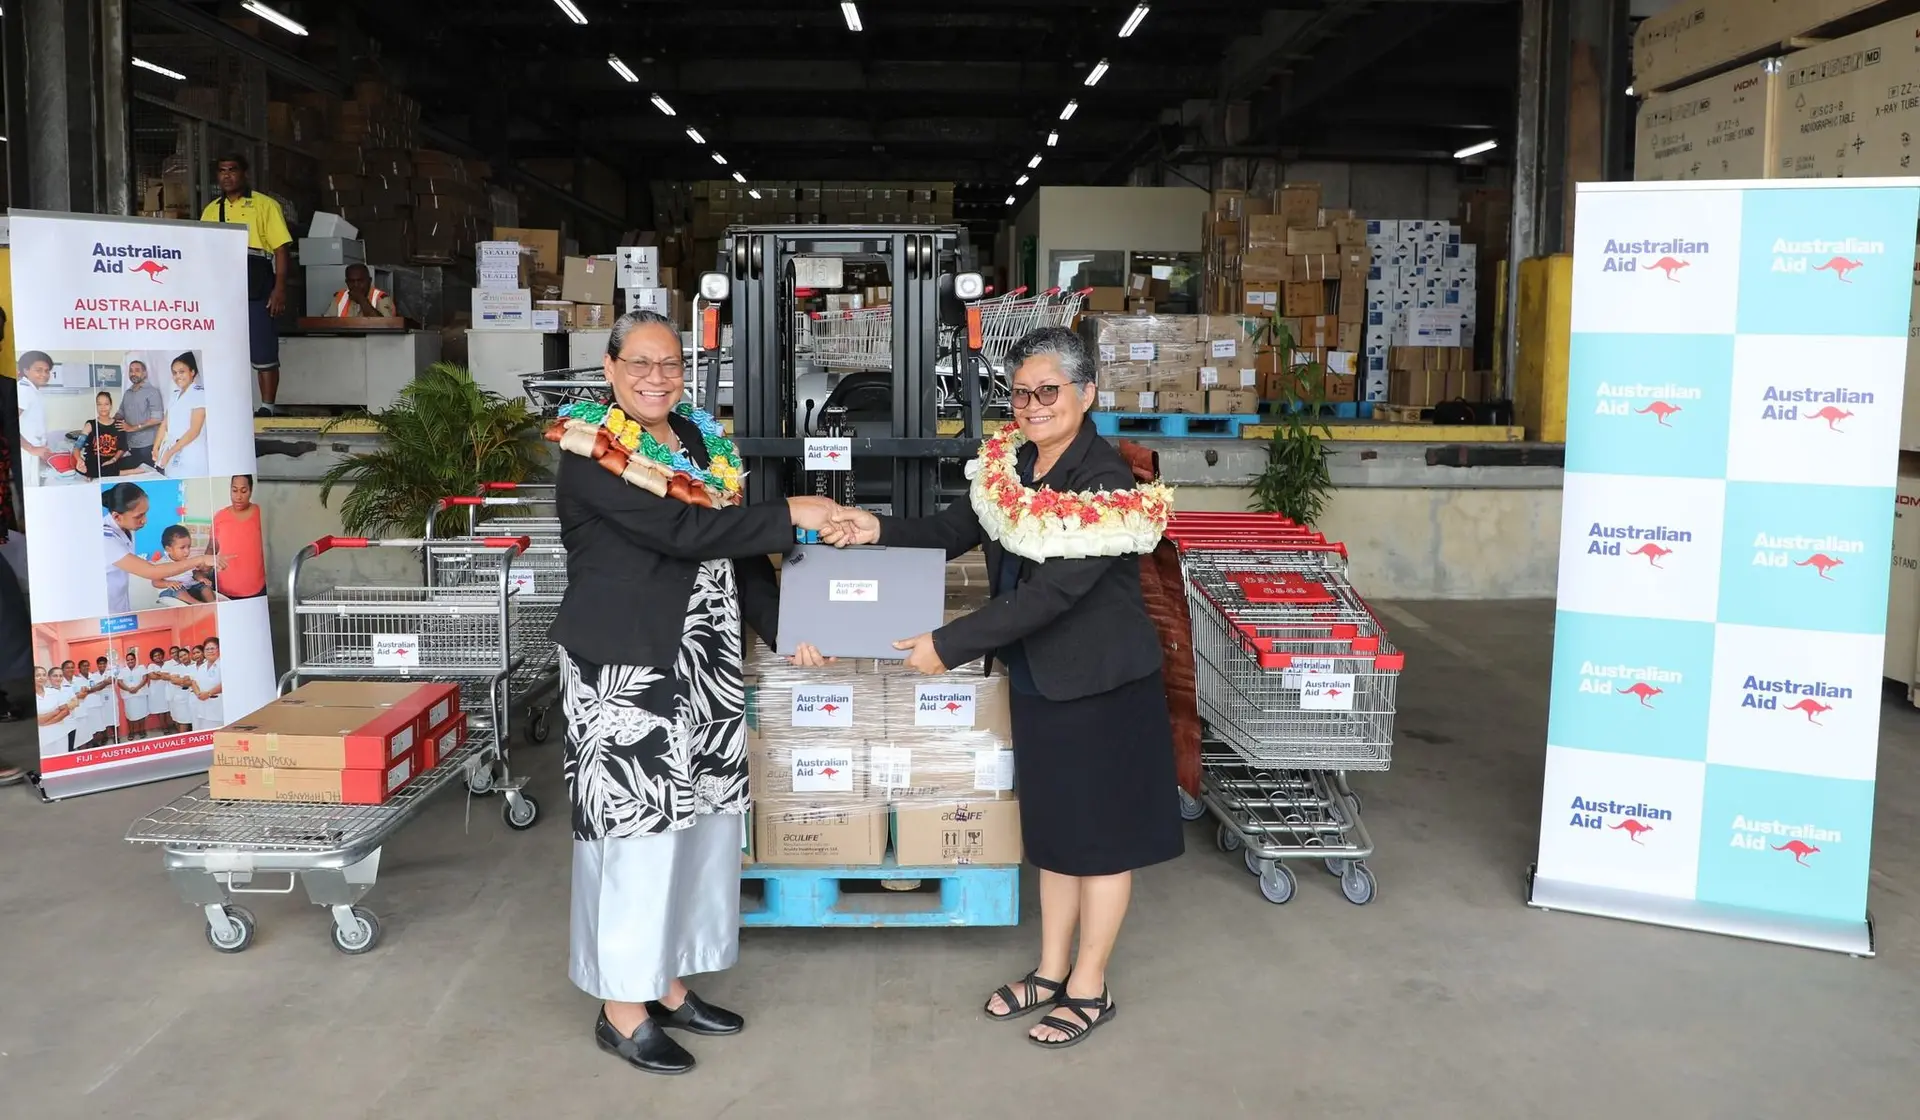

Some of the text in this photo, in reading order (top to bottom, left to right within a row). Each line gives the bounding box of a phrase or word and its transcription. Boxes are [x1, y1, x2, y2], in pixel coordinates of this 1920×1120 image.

[1867, 51, 1879, 62] MD
[1733, 77, 1758, 92] WDM
[1875, 97, 1920, 117] X-RAY TUBE
[92, 242, 182, 260] Australian
[1603, 238, 1709, 254] Australian
[1771, 238, 1884, 254] Australian
[93, 260, 124, 274] Aid
[1602, 257, 1636, 272] Aid
[1770, 258, 1807, 273] Aid
[74, 298, 200, 313] AUSTRALIA-FIJI
[64, 317, 215, 331] HEALTH PROGRAM
[1596, 382, 1701, 400] Australian
[1762, 386, 1874, 404] Australian
[1594, 400, 1629, 416] Aid
[1761, 405, 1798, 421] Aid
[808, 444, 848, 452] Australian
[1588, 522, 1692, 542] Australian
[1587, 540, 1620, 556] Aid
[1752, 532, 1864, 553] Australian
[1752, 552, 1788, 568] Aid
[1892, 556, 1918, 570] STAND
[376, 640, 416, 648] Australian
[1579, 660, 1683, 684] Australian
[1305, 680, 1351, 688] Australian
[1578, 678, 1612, 696] Aid
[1742, 675, 1853, 699] Australian
[796, 694, 849, 703] Australian
[920, 692, 972, 702] Australian
[1304, 688, 1320, 697] Aid
[796, 703, 814, 712] Aid
[920, 702, 936, 712] Aid
[1741, 693, 1777, 710] Aid
[76, 754, 93, 764] FIJI
[101, 745, 151, 759] AUSTRALIA
[152, 738, 186, 750] VUVALE
[796, 758, 848, 767] Australian
[796, 768, 814, 776] Aid
[1570, 796, 1672, 821] Australian
[1569, 813, 1602, 830] Aid
[1731, 814, 1842, 843] Australian
[1730, 832, 1766, 850] Aid
